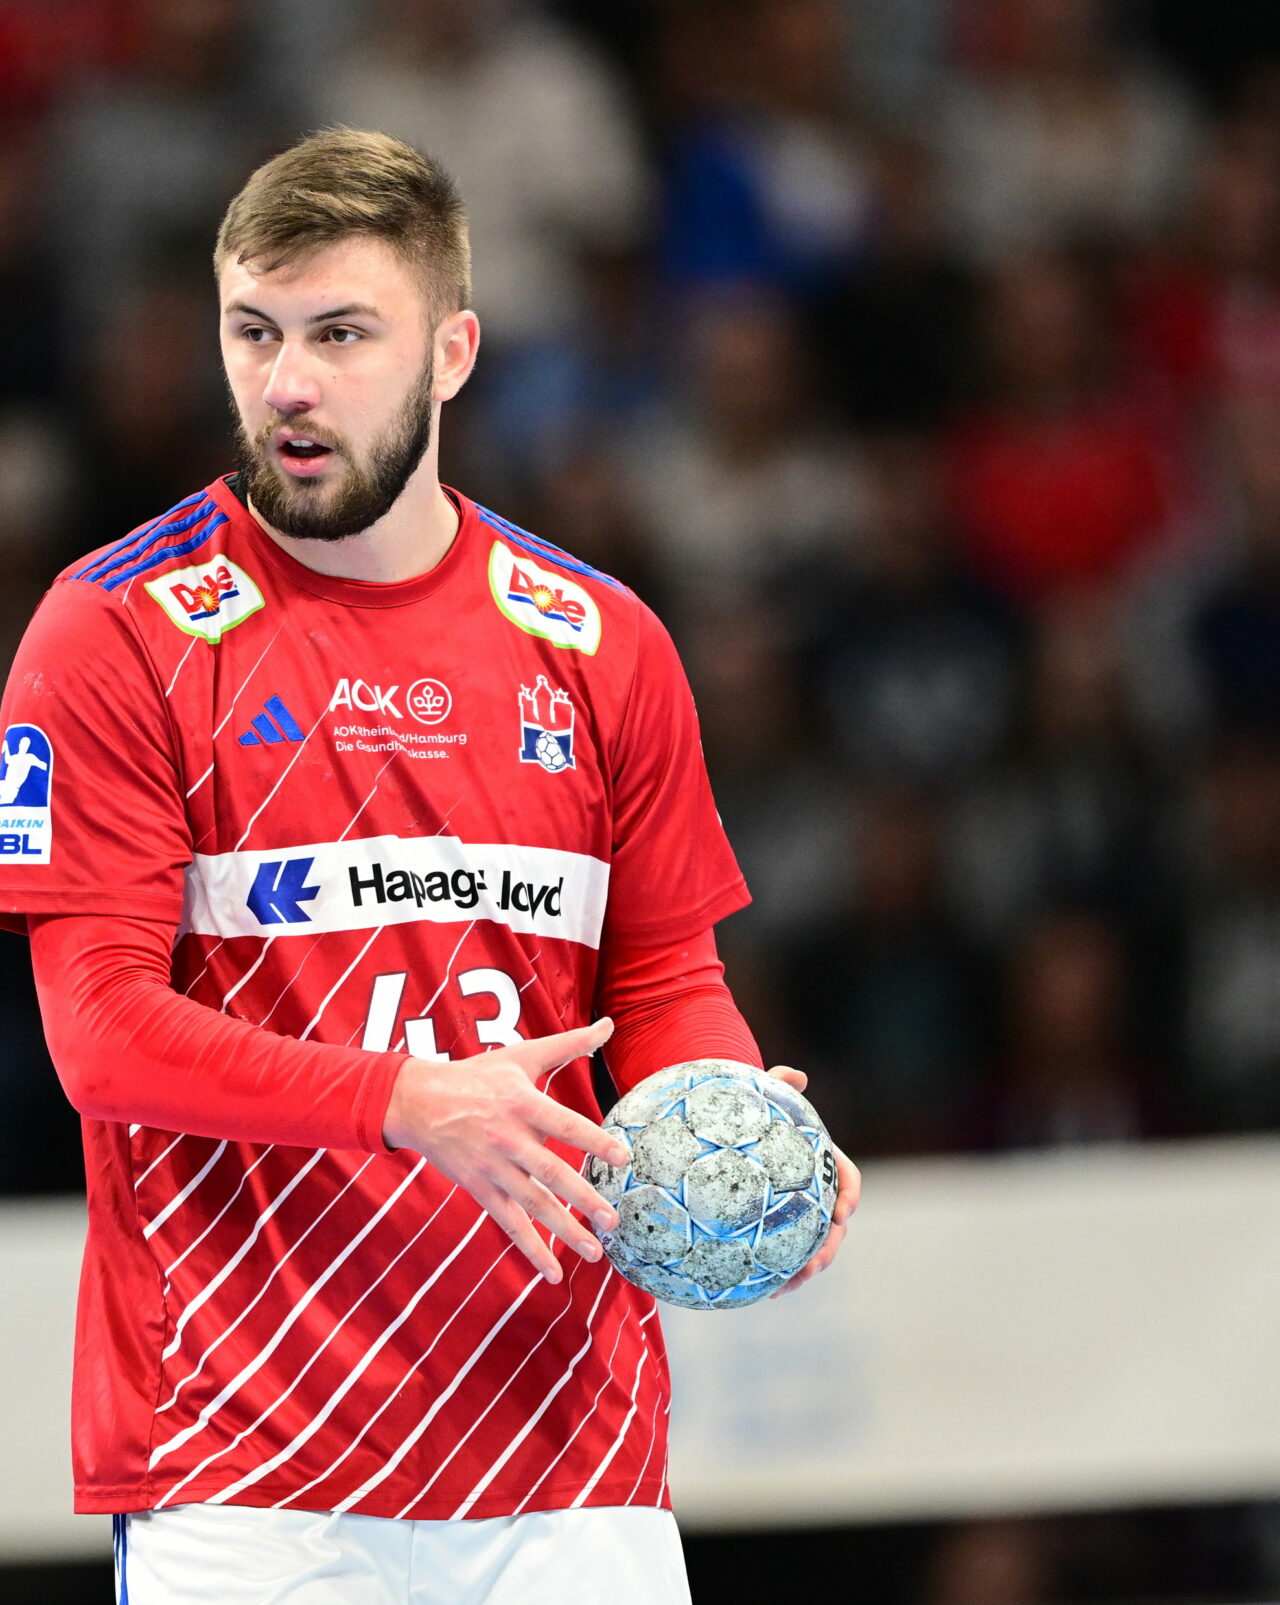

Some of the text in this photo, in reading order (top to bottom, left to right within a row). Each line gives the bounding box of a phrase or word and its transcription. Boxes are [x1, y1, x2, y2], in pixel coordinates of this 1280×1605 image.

[169, 565, 234, 614] Dole
[508, 563, 587, 624] Dole
[328, 678, 404, 718] AOK
[336, 741, 354, 751] Die
